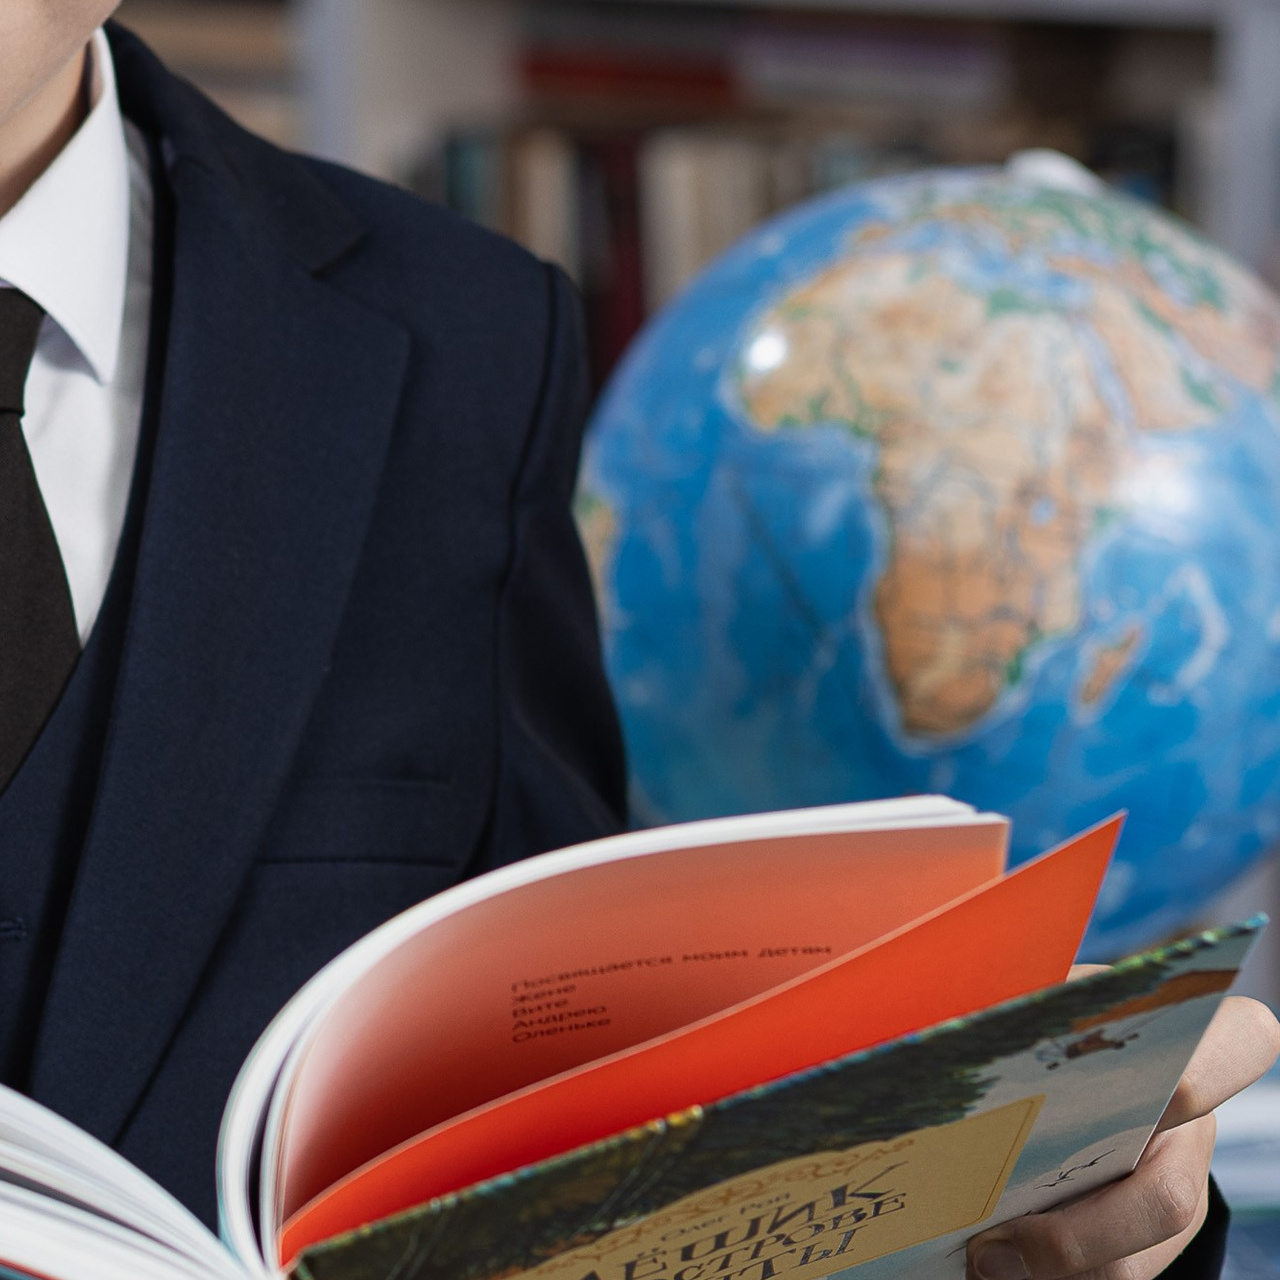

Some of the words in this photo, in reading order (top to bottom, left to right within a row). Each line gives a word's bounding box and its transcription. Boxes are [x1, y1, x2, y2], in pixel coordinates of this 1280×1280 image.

[511, 956, 672, 993] Посвящается
[681, 951, 749, 963] моим
[512, 984, 576, 1004] Жене
[511, 1005, 607, 1032] Андрею
[512, 999, 568, 1019] Вите
[512, 1018, 611, 1043] Оленьке
[660, 1217, 723, 1242] Олег
[740, 1192, 792, 1214] Рой
